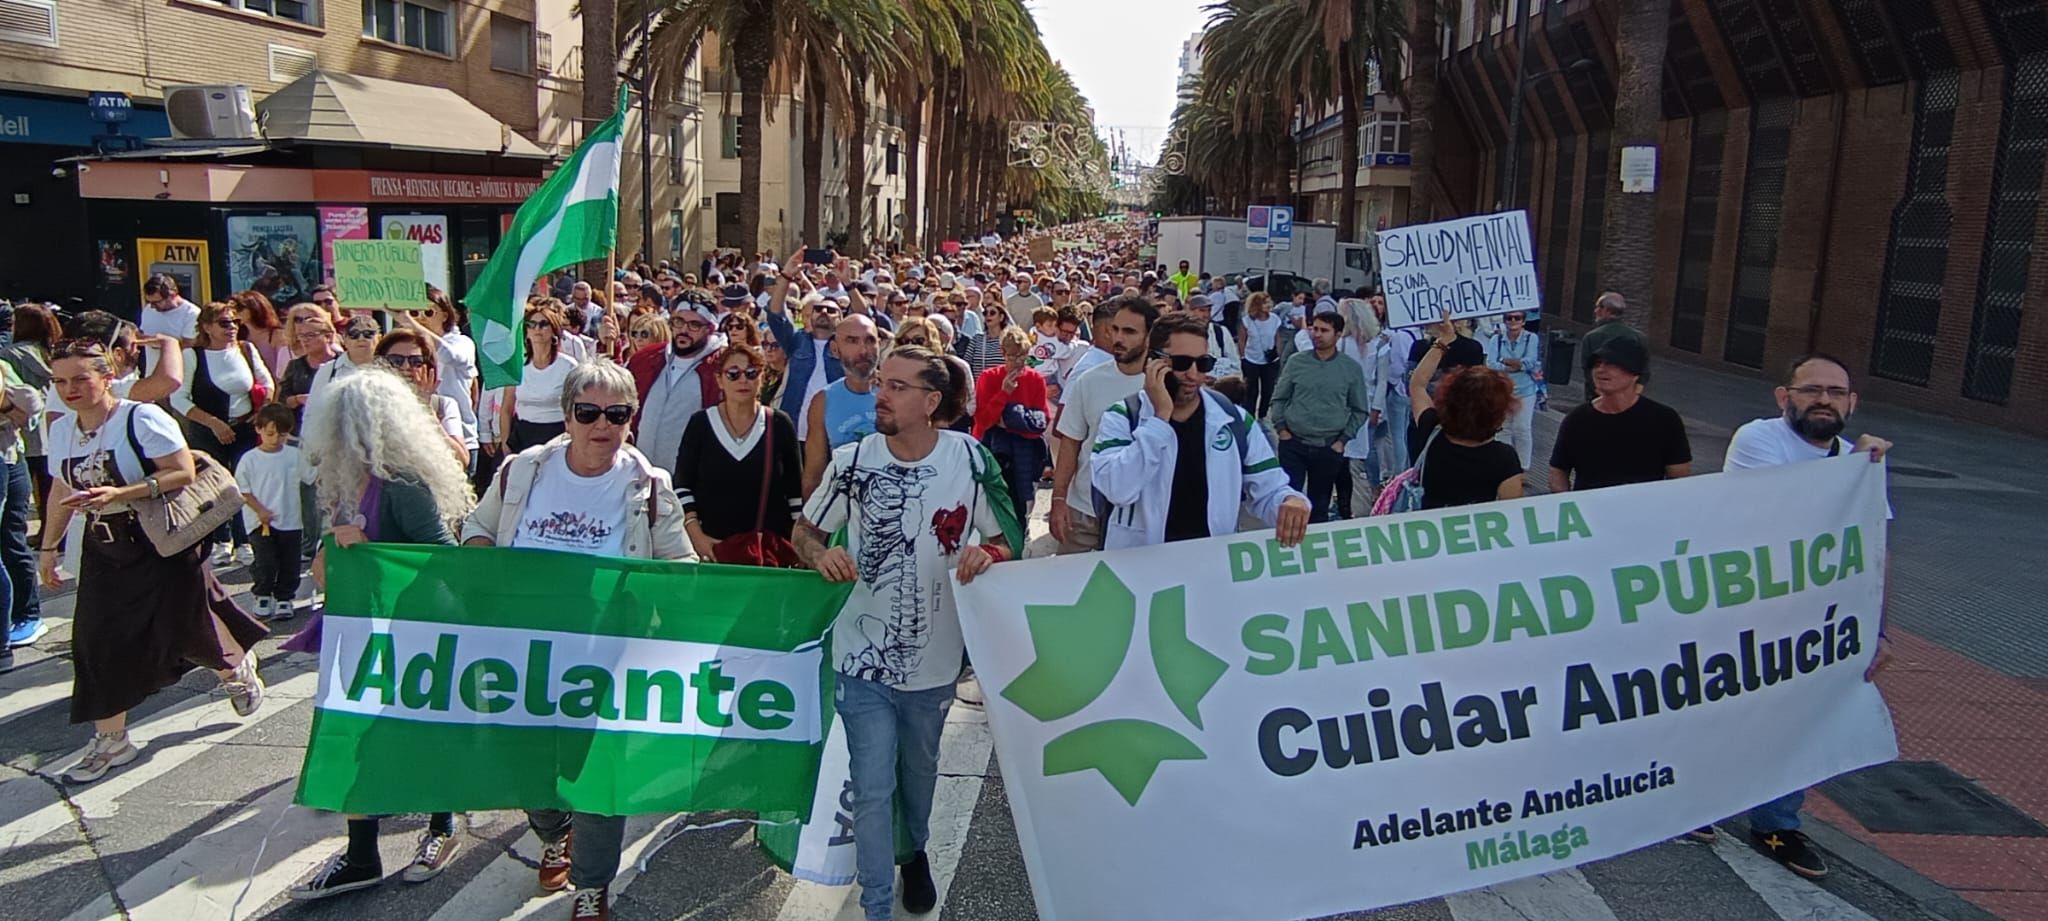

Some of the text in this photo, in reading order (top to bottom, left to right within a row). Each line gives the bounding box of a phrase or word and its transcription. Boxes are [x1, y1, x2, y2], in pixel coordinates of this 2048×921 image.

[99, 97, 131, 108] ATM
[1272, 209, 1289, 231] P
[407, 224, 442, 244] MAS
[164, 245, 199, 261] ATM
[335, 241, 375, 262] DINERO
[338, 276, 384, 303] SANIDAD
[1386, 272, 1430, 295] ES UNA
[1227, 501, 1592, 583] DEFENDER LA
[1240, 525, 1865, 677] SANIDAD PÚBLICA
[346, 633, 796, 730] Adelante
[1257, 603, 1861, 777] Cuidar Andalucía
[1353, 761, 1675, 850] Adelante Andalucía
[1465, 823, 1589, 870] Málaga
